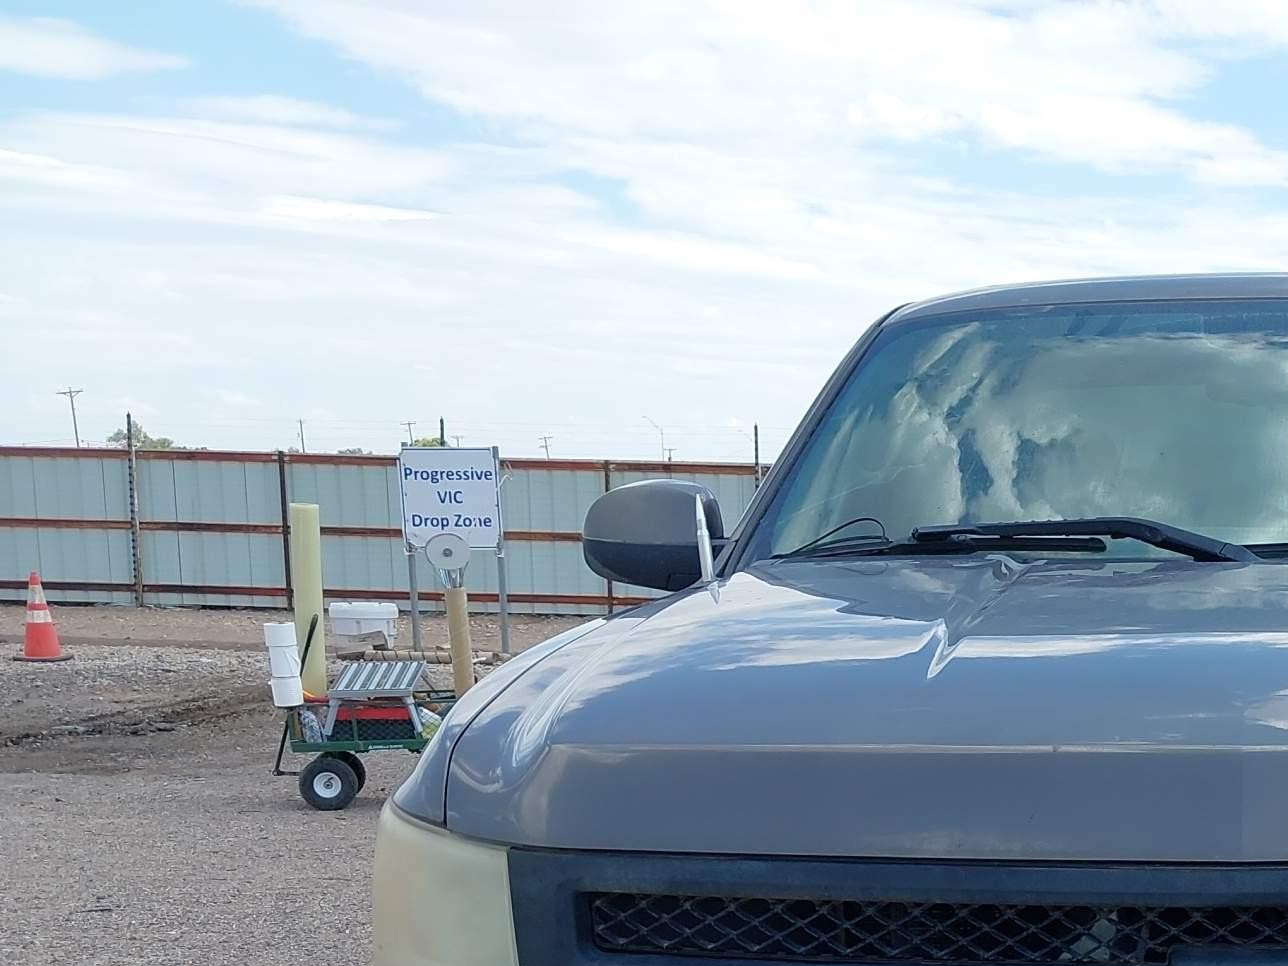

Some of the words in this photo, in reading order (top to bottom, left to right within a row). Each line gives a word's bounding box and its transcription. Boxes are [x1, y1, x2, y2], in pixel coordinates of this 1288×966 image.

[404, 466, 493, 484] Progressive
[437, 490, 463, 504] VIC
[412, 514, 450, 530] Drop
[454, 514, 492, 527] Zone
